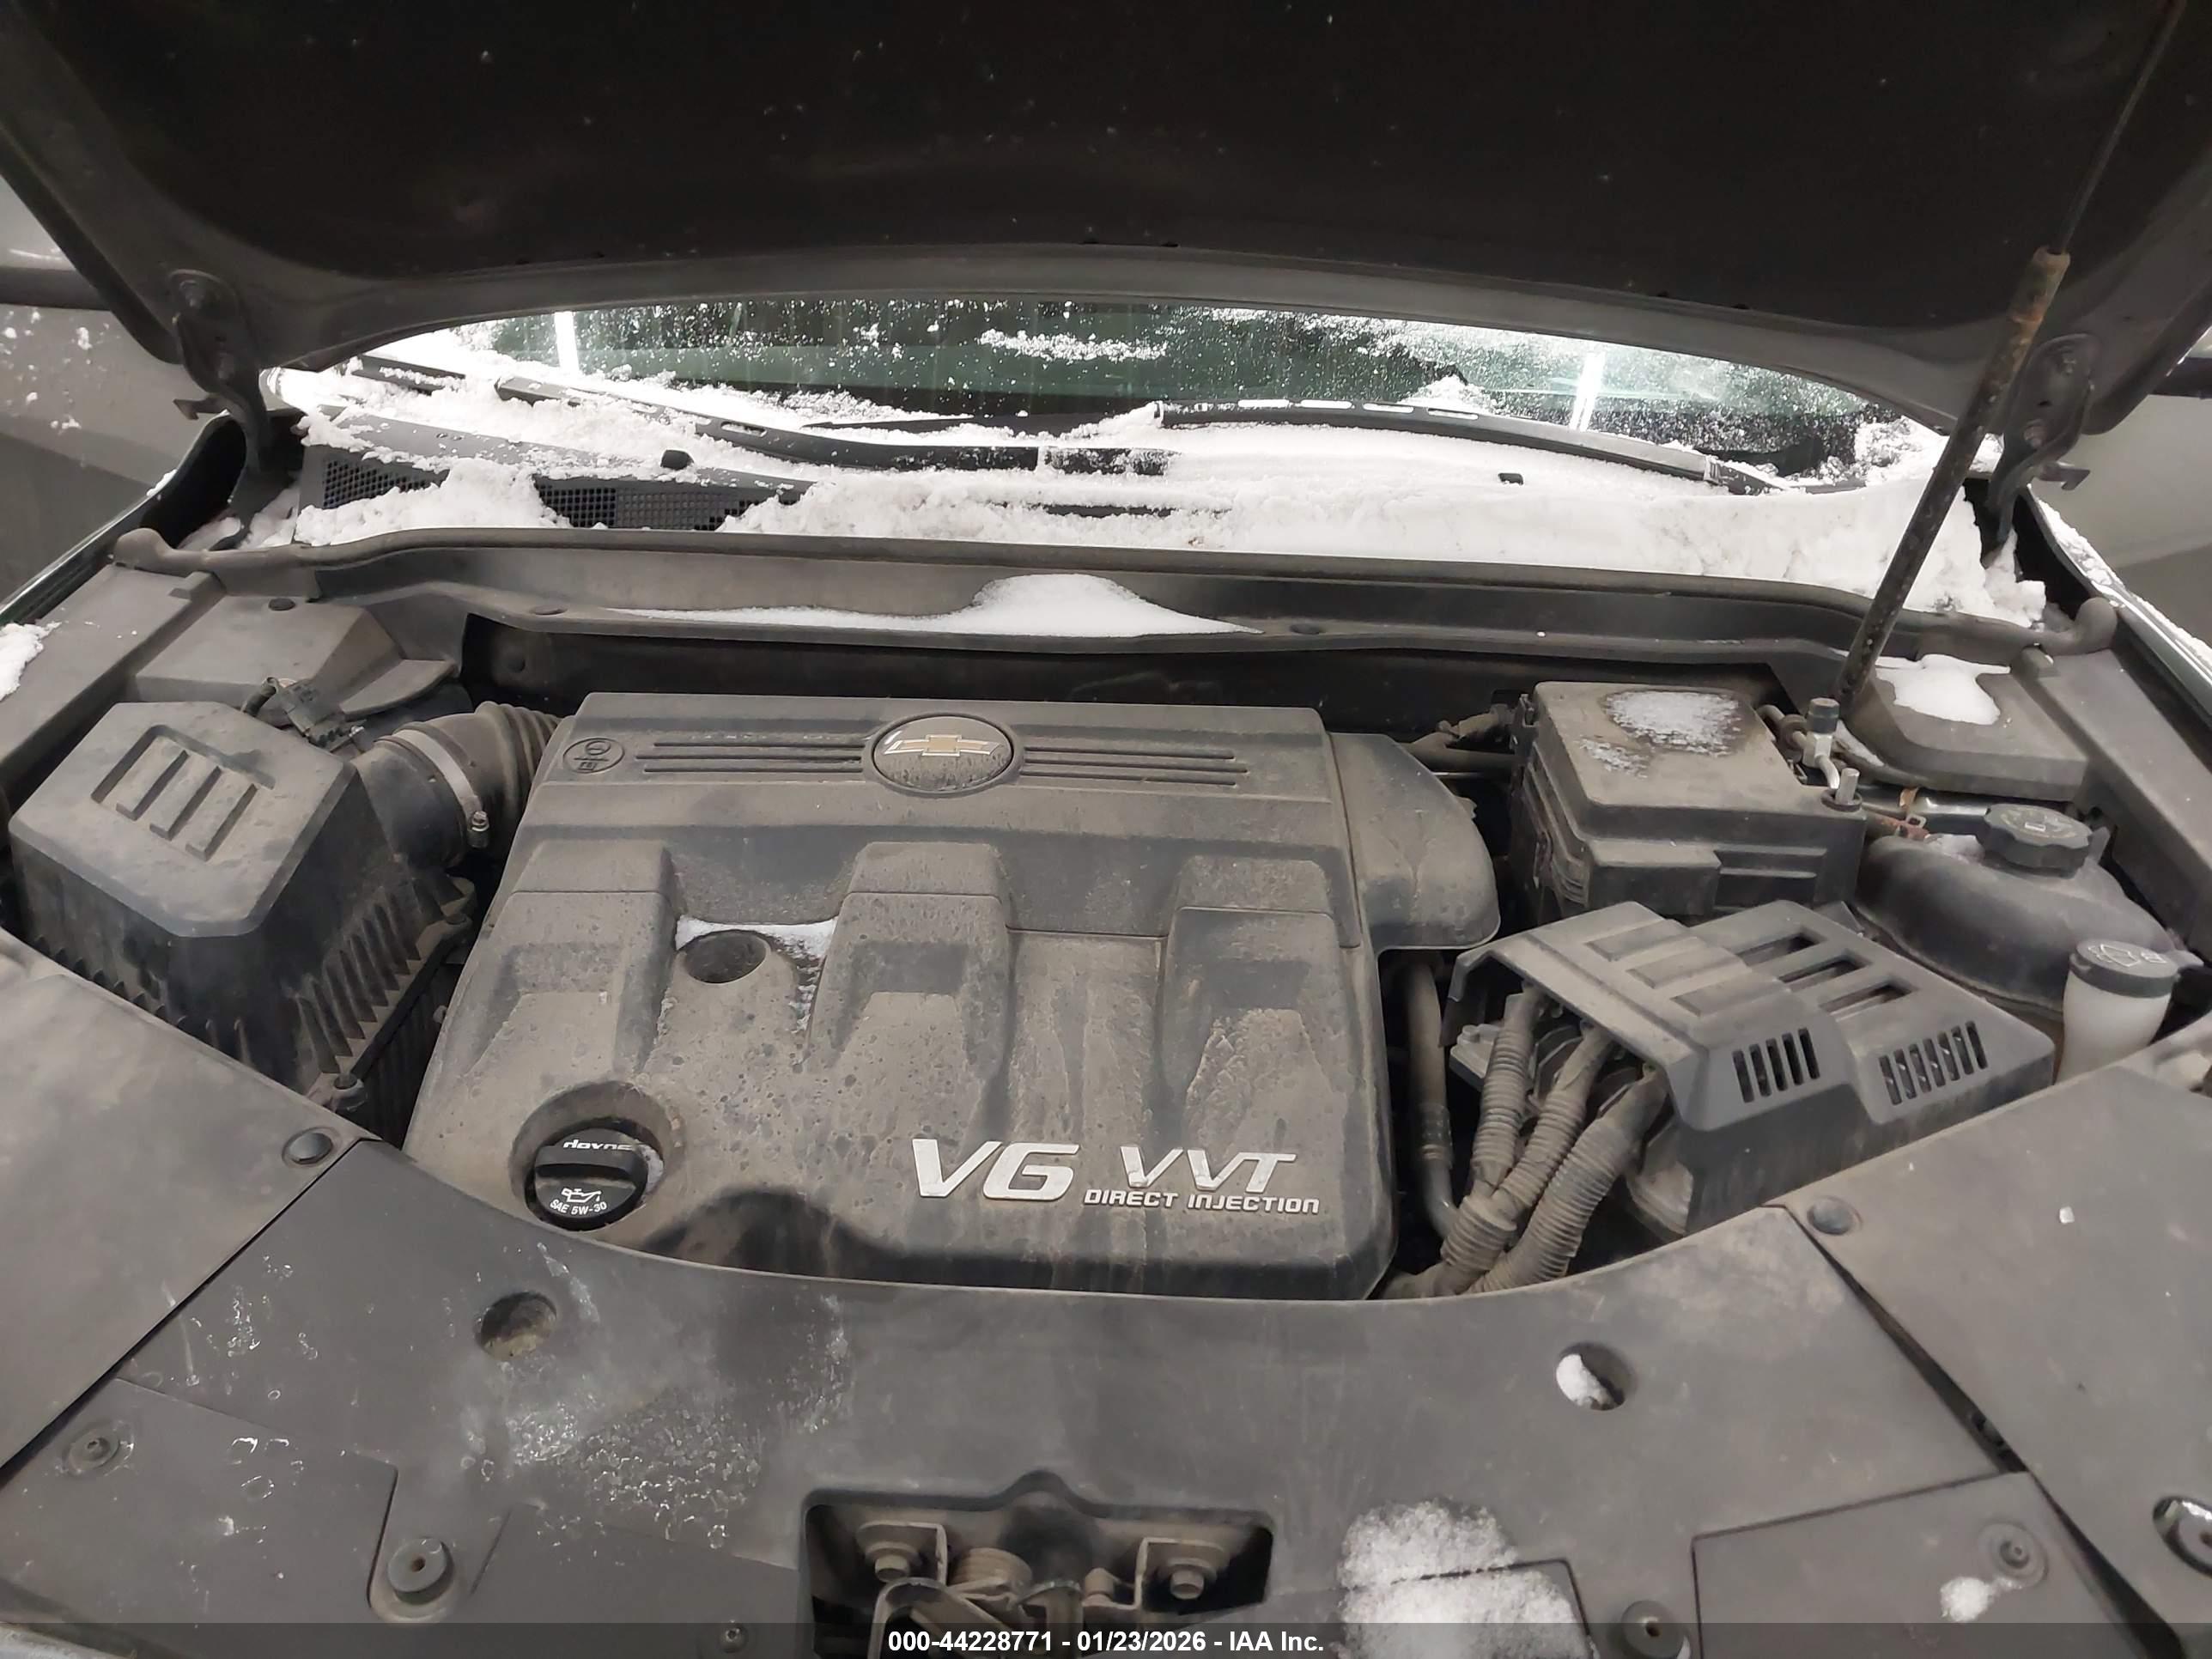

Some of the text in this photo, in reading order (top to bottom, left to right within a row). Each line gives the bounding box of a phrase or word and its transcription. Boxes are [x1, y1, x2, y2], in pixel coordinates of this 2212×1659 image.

[912, 1138, 1297, 1200] V6 VVT
[550, 1199, 608, 1215] SAE 5W-30
[1084, 1188, 1320, 1213] DIRECT INJECTION
